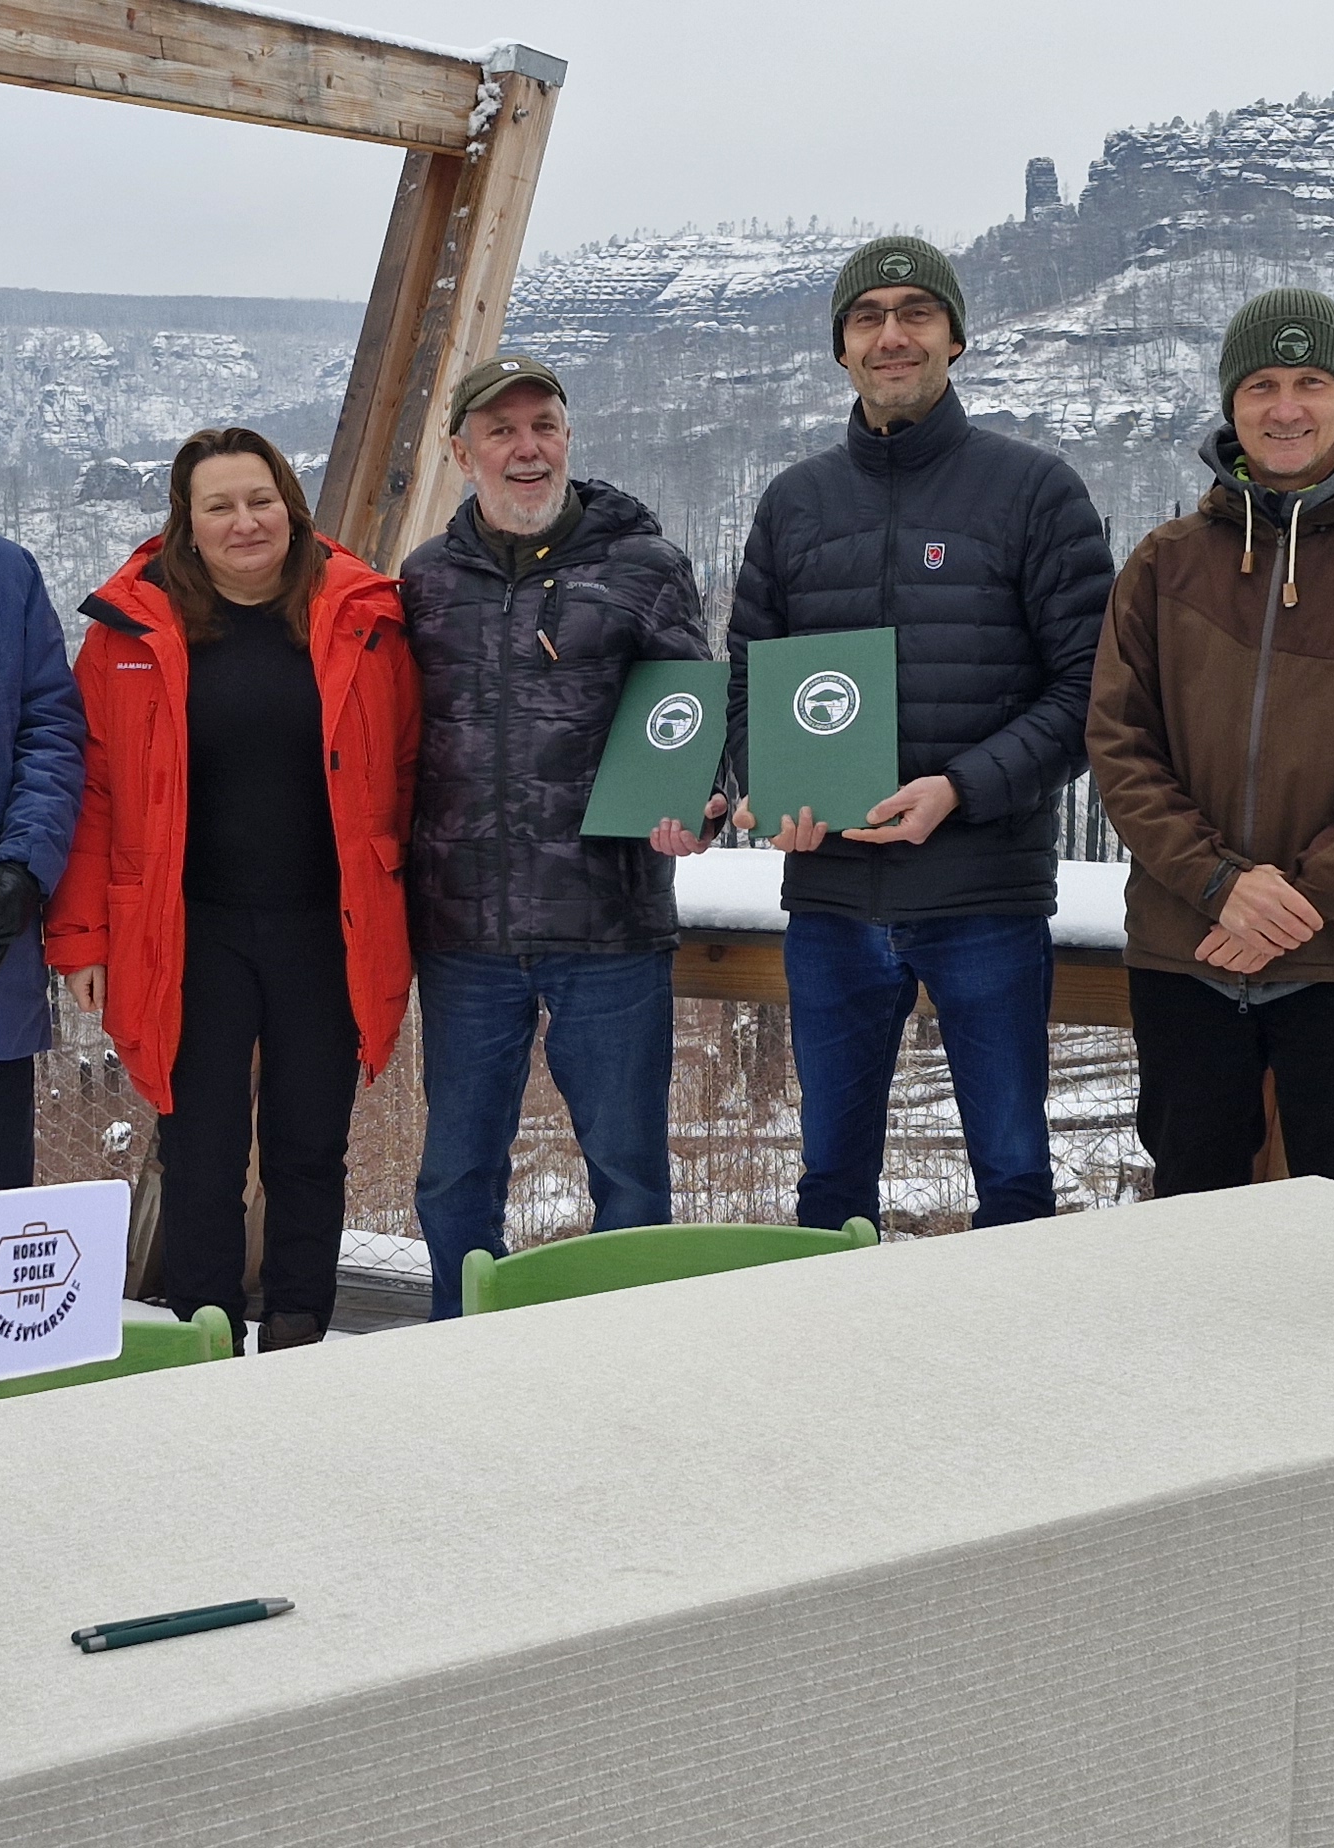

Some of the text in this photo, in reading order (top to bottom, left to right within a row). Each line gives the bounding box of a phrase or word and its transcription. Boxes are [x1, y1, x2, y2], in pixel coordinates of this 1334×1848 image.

[12, 1237, 58, 1261] HORSKÝ
[12, 1262, 56, 1283] SPOLEK
[22, 1293, 40, 1306] PRO
[14, 1290, 77, 1342] ŠVÝCARSKO
